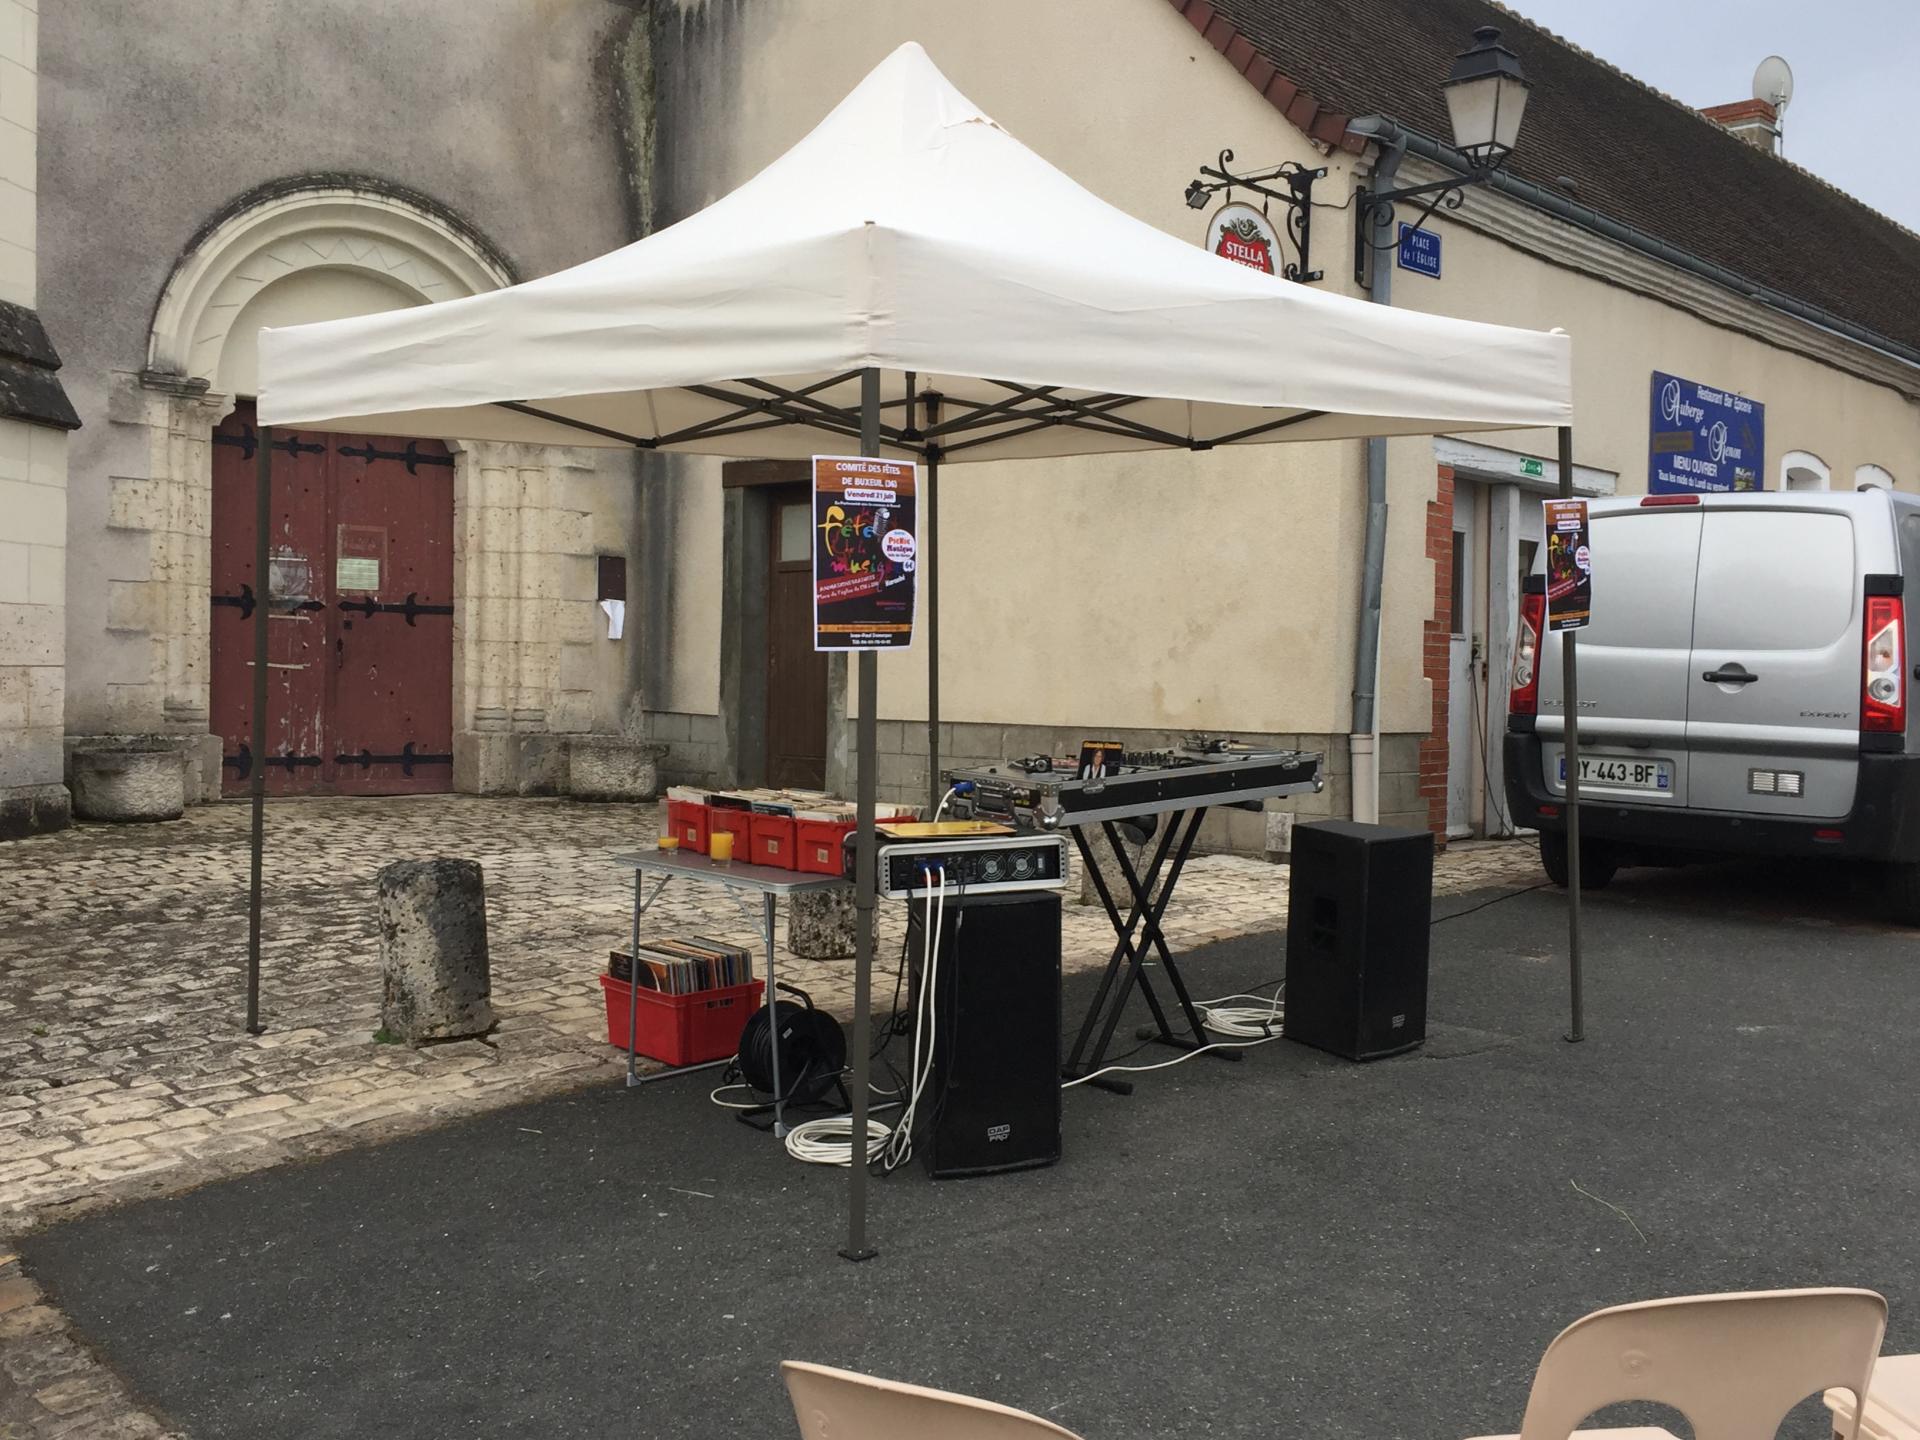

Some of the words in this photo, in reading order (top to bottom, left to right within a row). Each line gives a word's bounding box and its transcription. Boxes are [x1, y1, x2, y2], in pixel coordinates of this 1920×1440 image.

[1412, 235, 1430, 250] PLACE
[1226, 241, 1264, 264] STELLA
[1403, 248, 1410, 260] de
[1661, 379, 1704, 426] Auberge
[836, 462, 867, 472] COMITÉ
[1673, 454, 1691, 471] MENU
[1692, 459, 1718, 477] OUVRIER
[841, 477, 852, 486] DE
[846, 490, 875, 499] Vendredi
[1800, 711, 1851, 719] EXPERT
[1577, 760, 1655, 783] Y-443-BF
